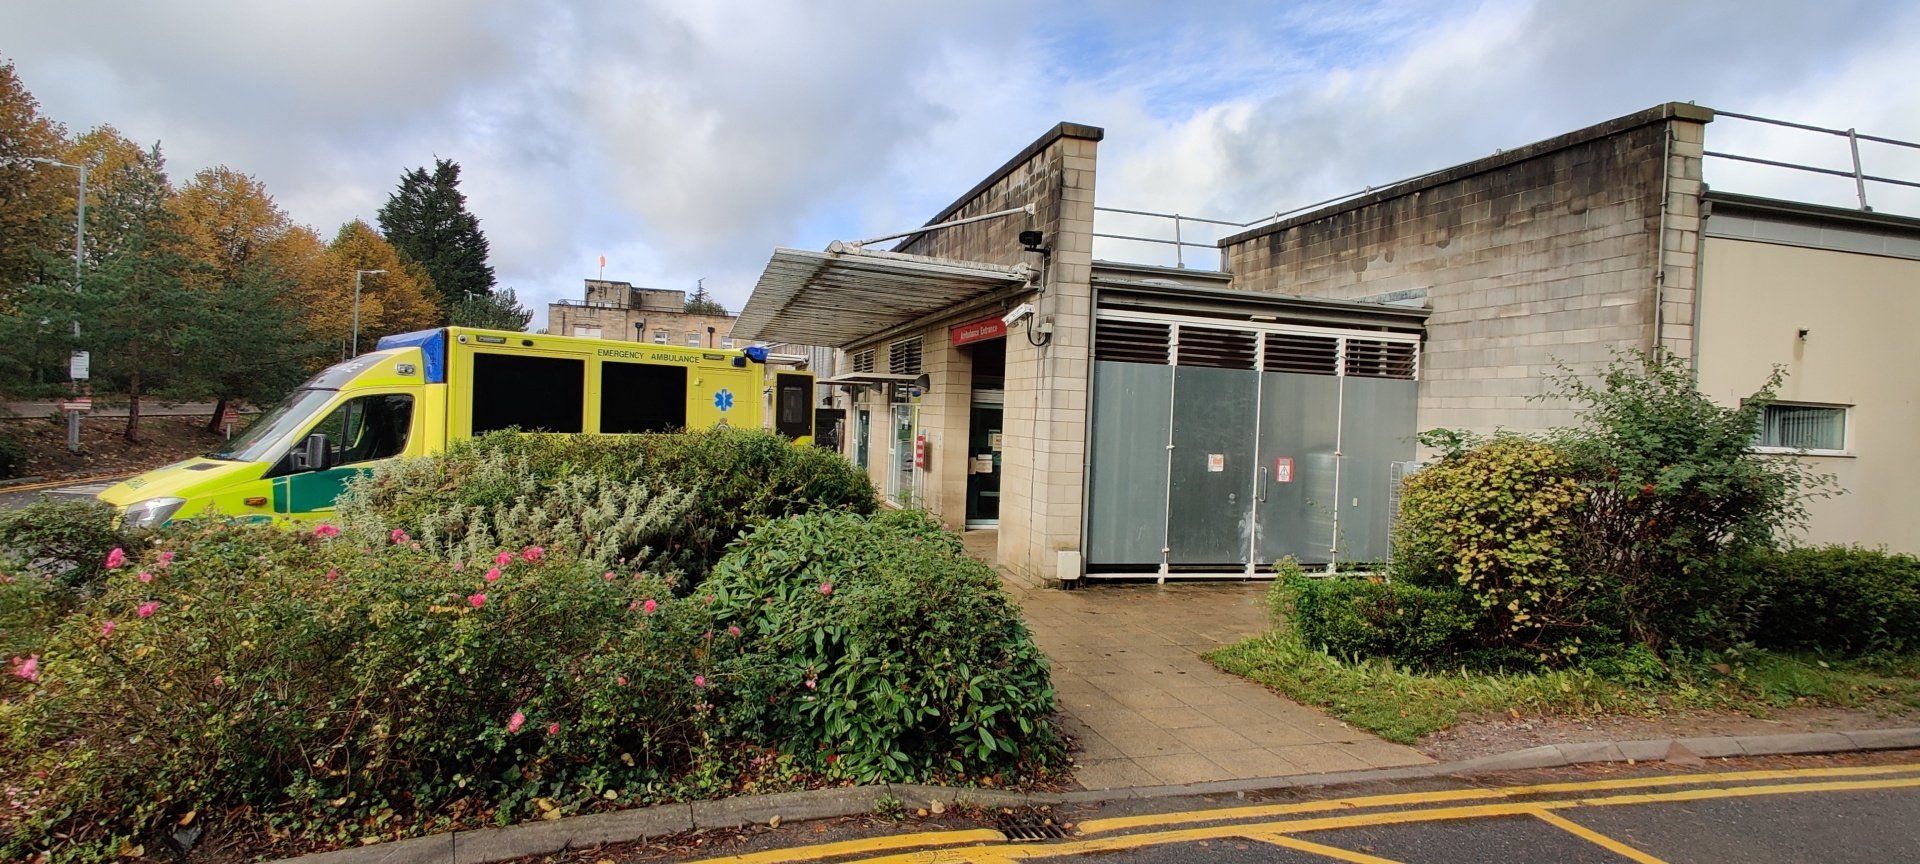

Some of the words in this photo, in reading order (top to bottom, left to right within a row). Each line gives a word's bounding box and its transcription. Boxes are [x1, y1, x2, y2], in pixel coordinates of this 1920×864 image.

[961, 329, 979, 339] Ambulance
[981, 325, 998, 335] Entrance
[597, 349, 644, 359] EMERGENCY
[651, 353, 700, 363] AMBULANCE
